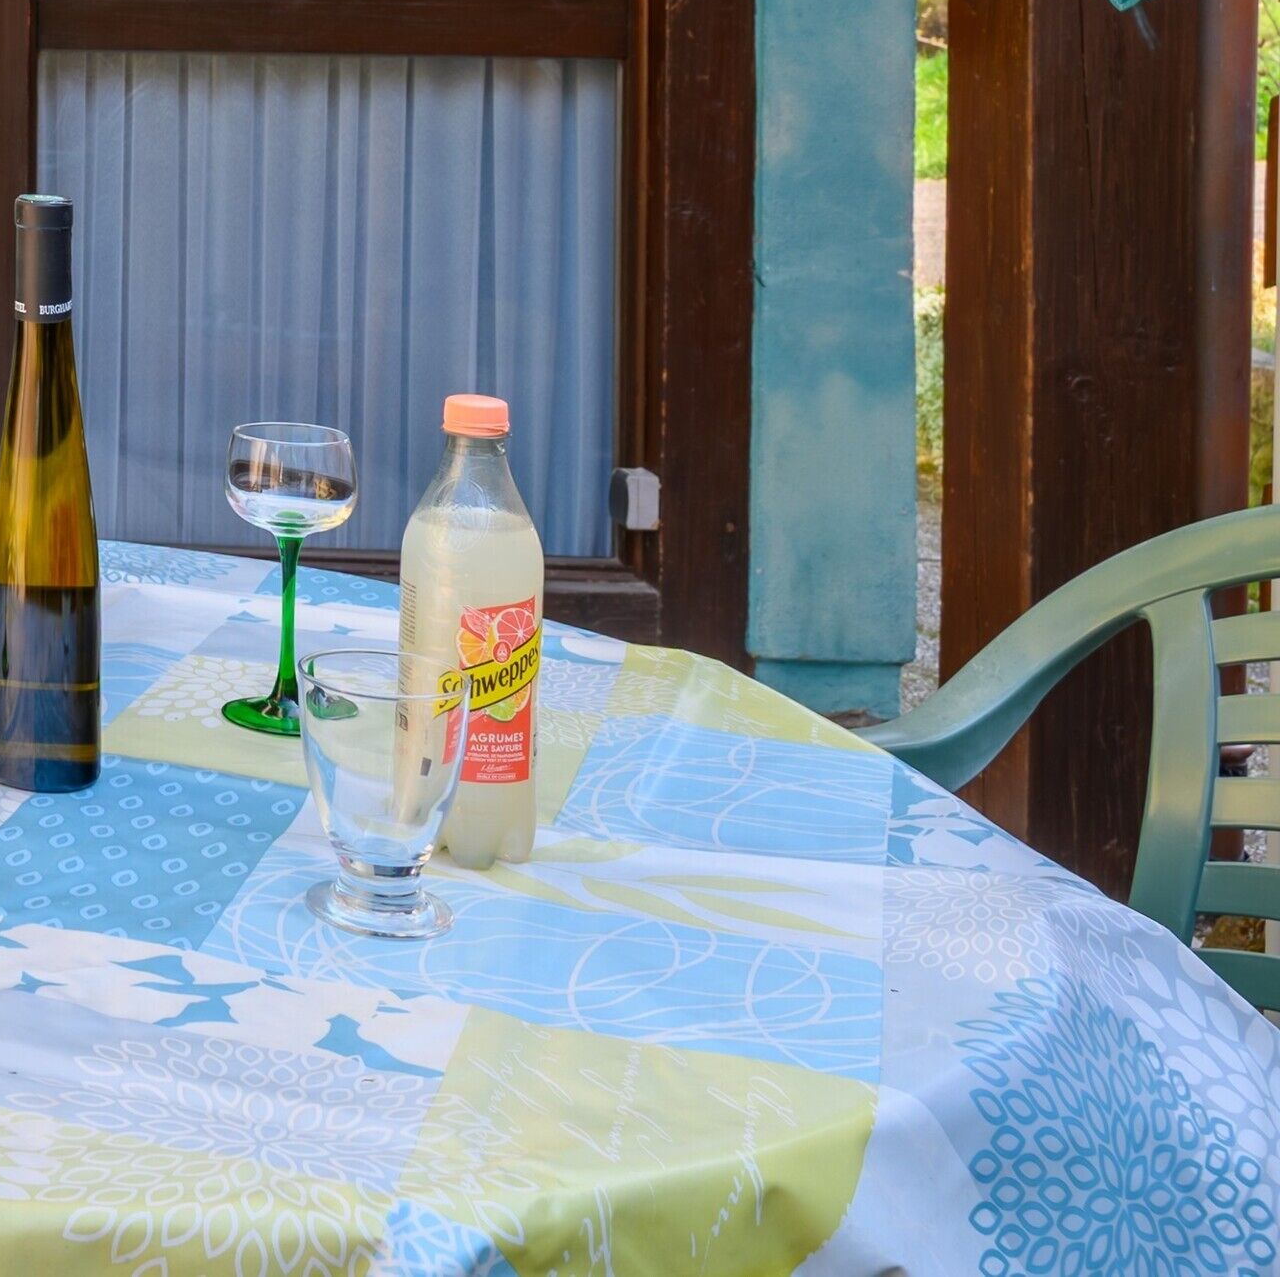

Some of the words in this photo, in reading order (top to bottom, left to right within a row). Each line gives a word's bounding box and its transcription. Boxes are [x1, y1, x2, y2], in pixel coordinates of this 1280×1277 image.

[439, 639, 539, 709] Schweppes
[470, 731, 524, 743] AGRUMES
[470, 744, 489, 752] AUX
